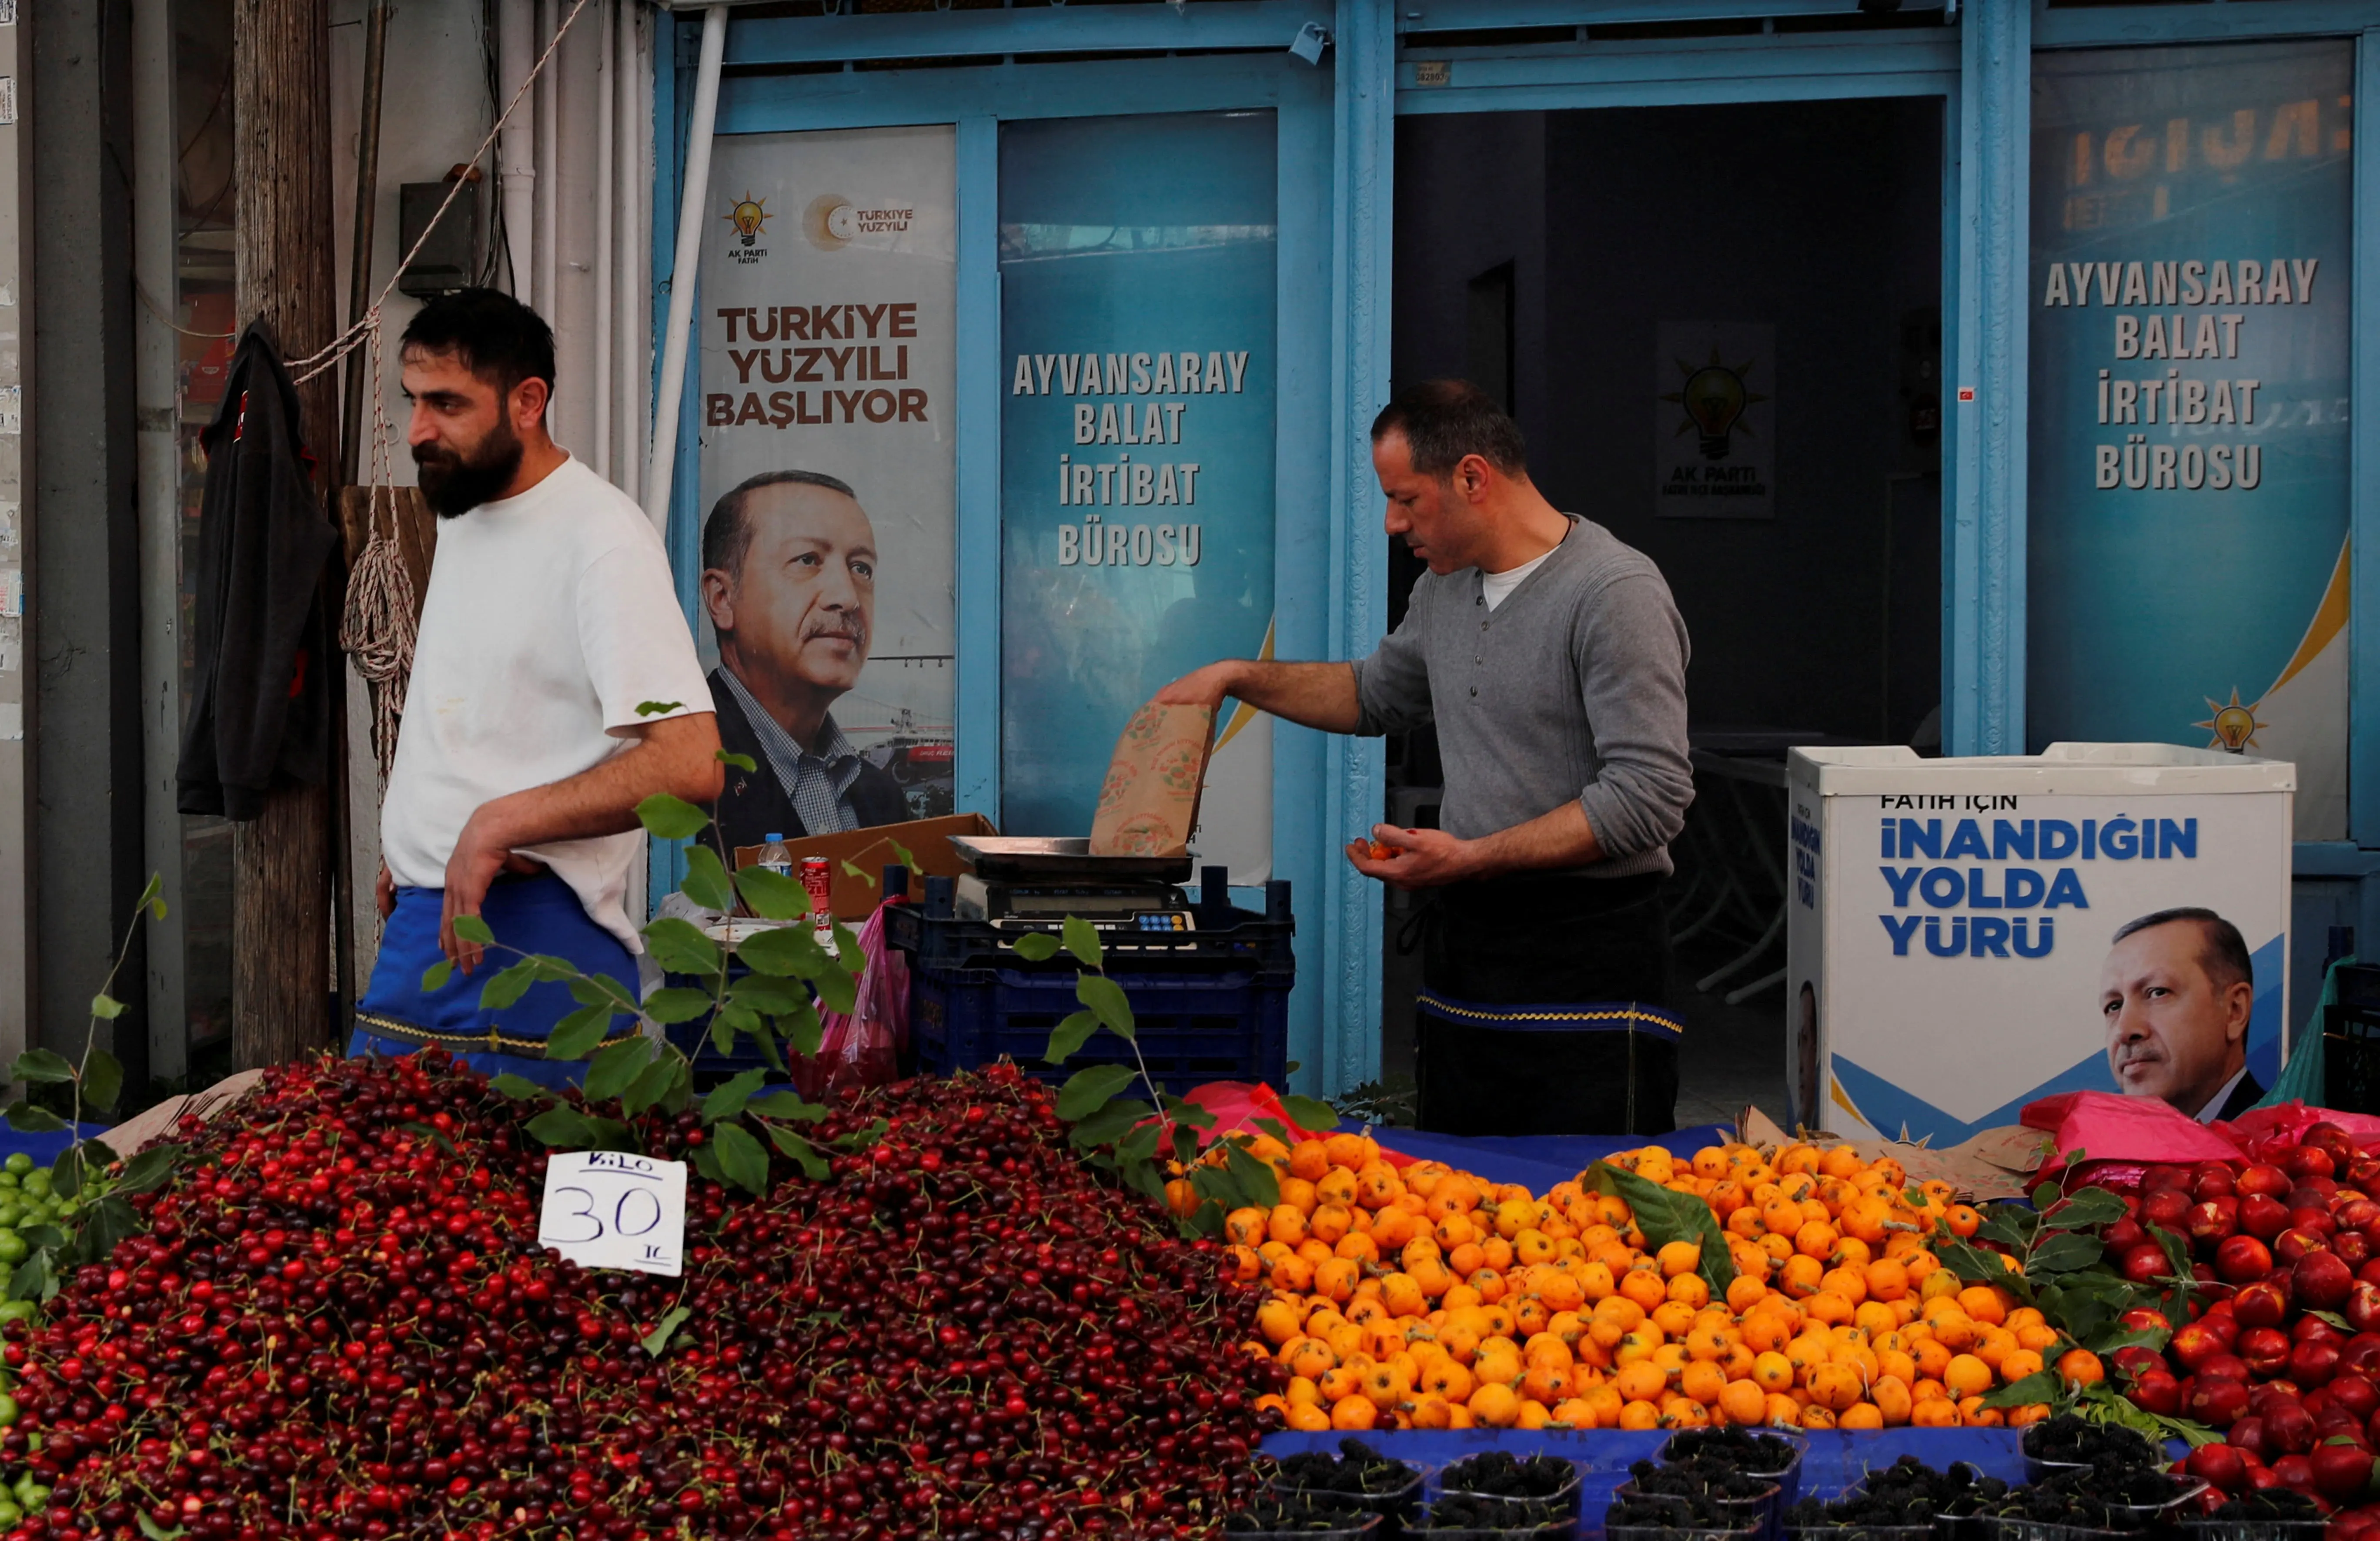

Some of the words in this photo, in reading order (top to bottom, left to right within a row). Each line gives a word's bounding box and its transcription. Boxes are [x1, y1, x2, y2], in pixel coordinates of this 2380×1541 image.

[857, 209, 913, 221] TÜRKİYE
[858, 222, 907, 232] YÜZYILI
[2044, 258, 2318, 307] AYVANSARAY
[717, 303, 917, 342] TÜRKİYE
[2115, 314, 2245, 360] BALAT
[728, 345, 907, 383] YÜZYILI
[1013, 351, 1249, 395] AYVANSARAY
[706, 389, 928, 429] BAŞLIYOR
[2098, 368, 2260, 425] İRTİBAT
[1074, 403, 1186, 445] BALAT
[1060, 453, 1200, 506] İRTİBAT
[1671, 466, 1698, 482] AK
[2096, 435, 2262, 490] BÜROSU
[1058, 514, 1201, 566] BÜROSU
[1881, 813, 2197, 861] İNANDIĞIN
[1879, 866, 2090, 910] YOLDA
[1878, 914, 2056, 958] YÜRÜ
[542, 1187, 661, 1243] 30
